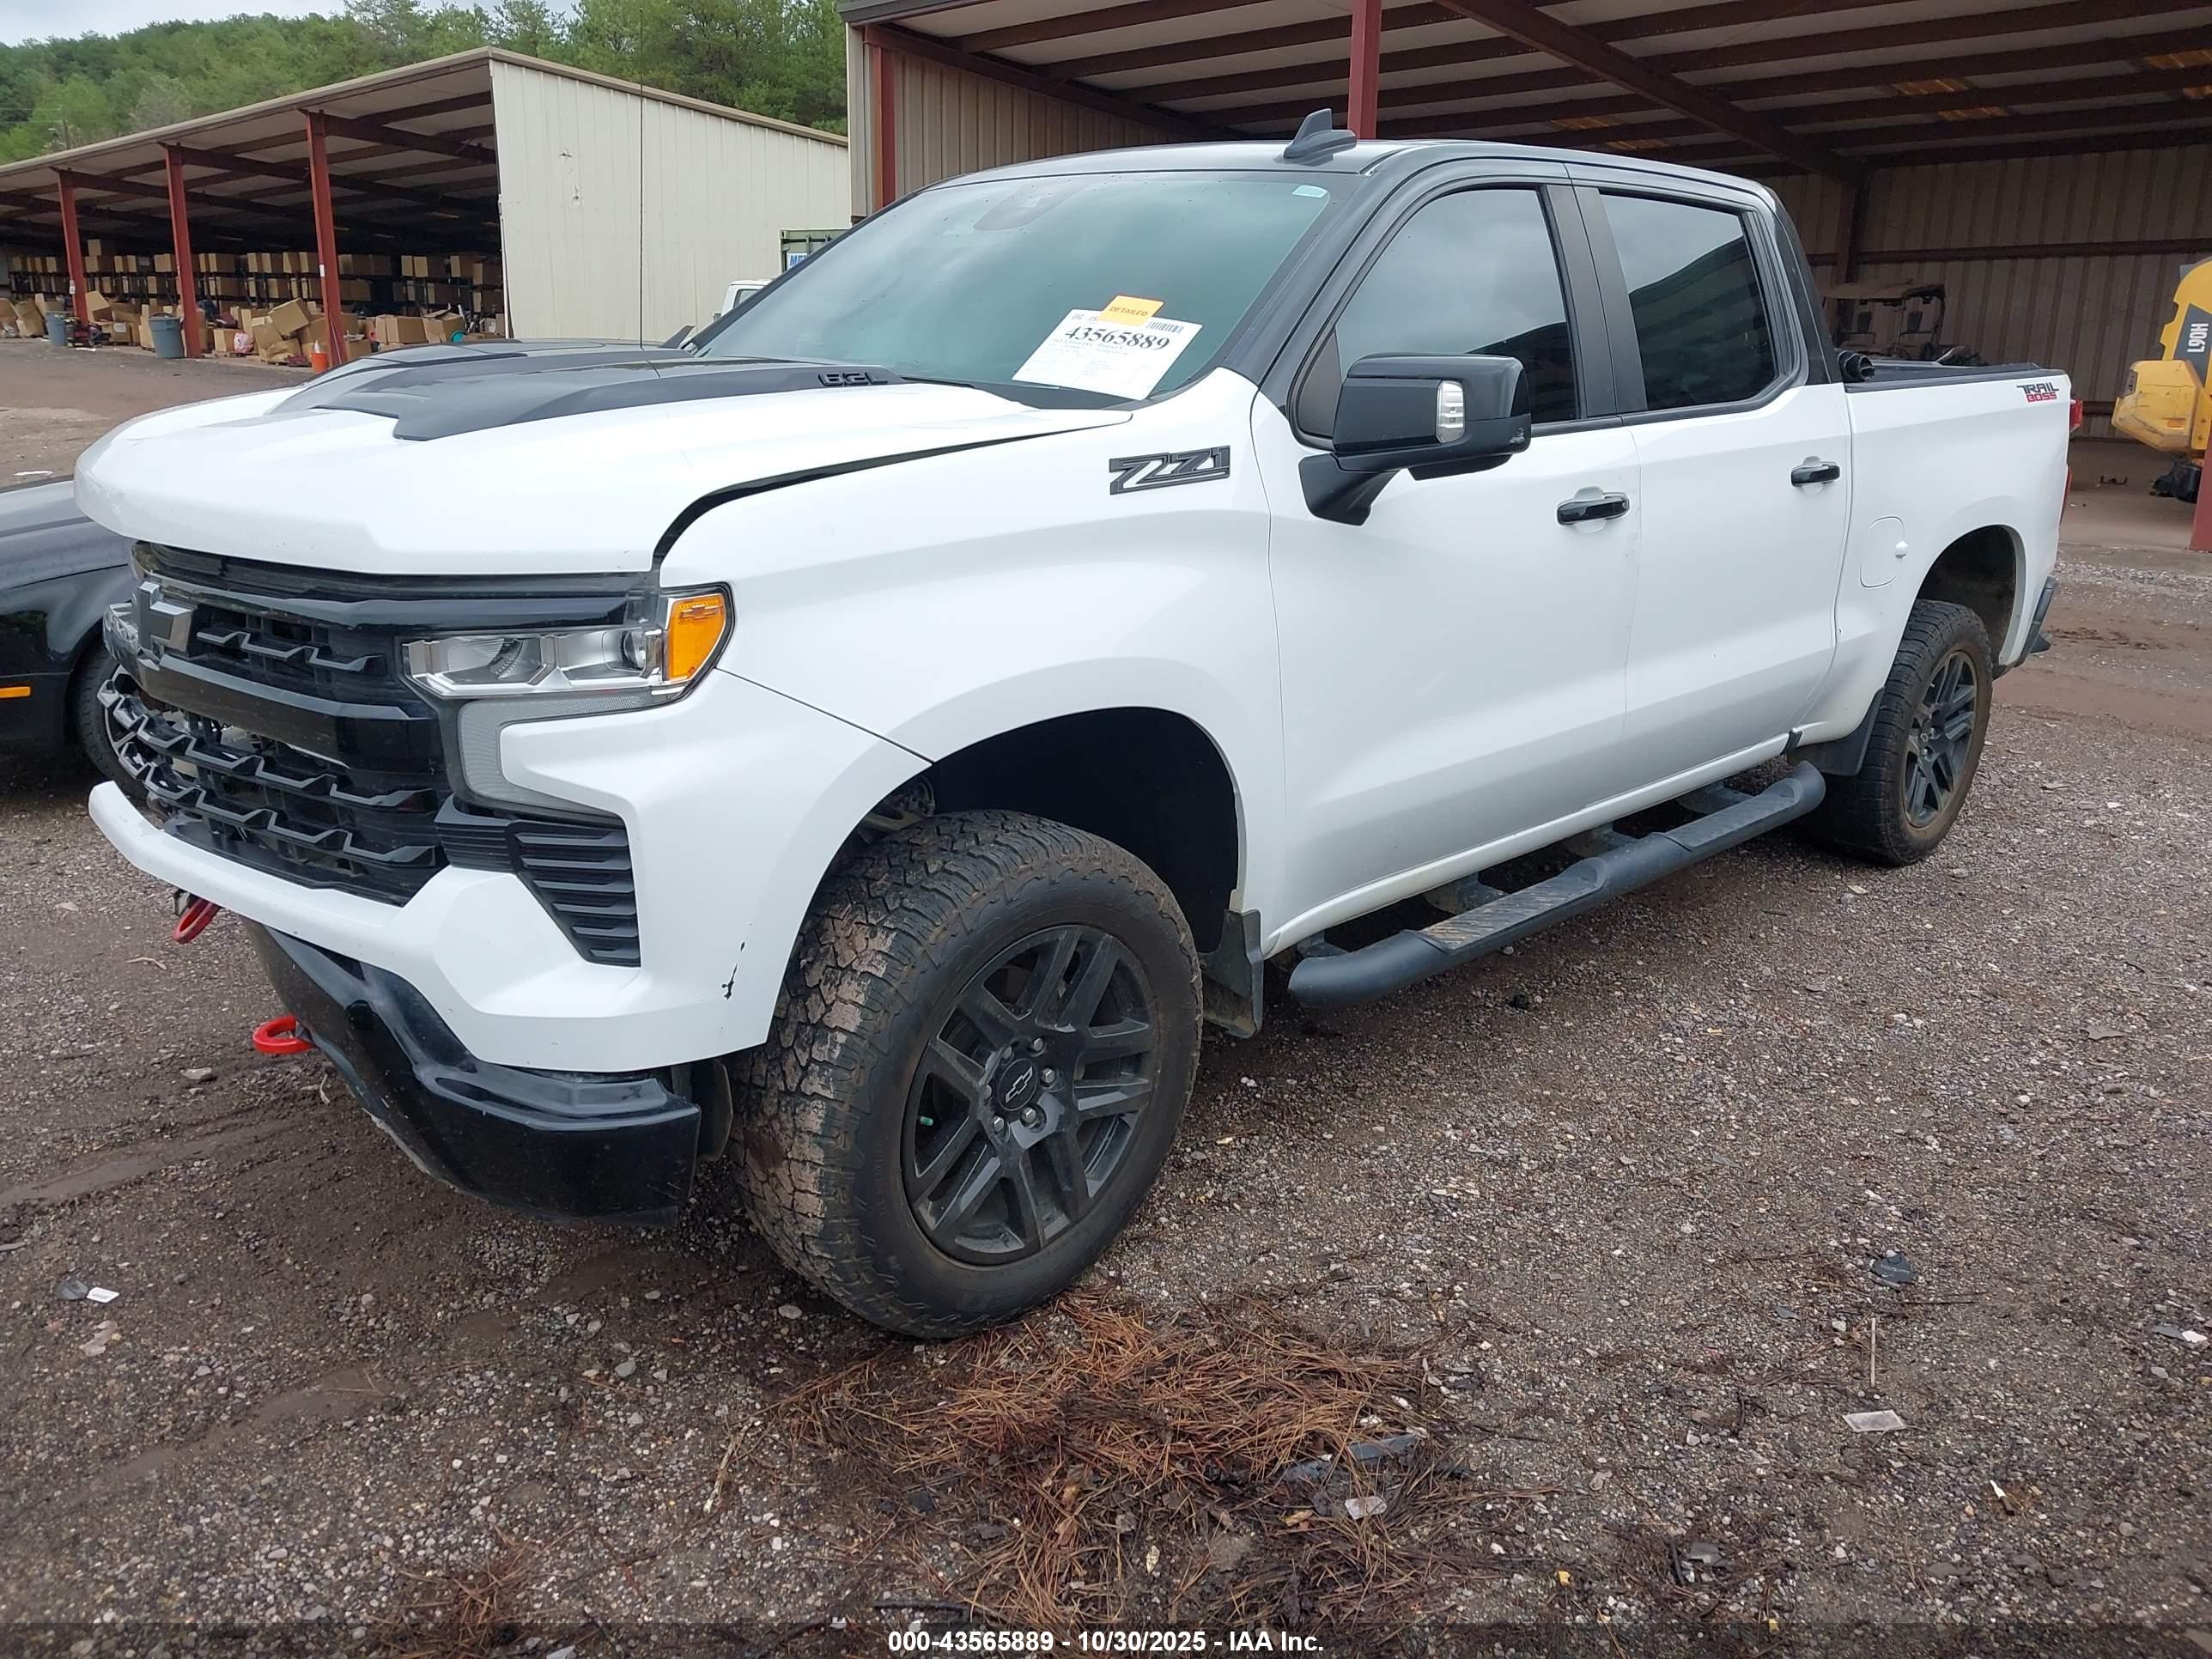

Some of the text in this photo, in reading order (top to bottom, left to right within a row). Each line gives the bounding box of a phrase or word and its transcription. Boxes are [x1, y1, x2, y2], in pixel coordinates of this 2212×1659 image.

[1109, 305, 1149, 318] DETAILED
[1064, 325, 1170, 350] 43565889
[2187, 323, 2209, 353] L90H
[2016, 382, 2060, 394] TRAIL
[2027, 392, 2057, 403] BOSS
[1109, 445, 1231, 495] Z71
